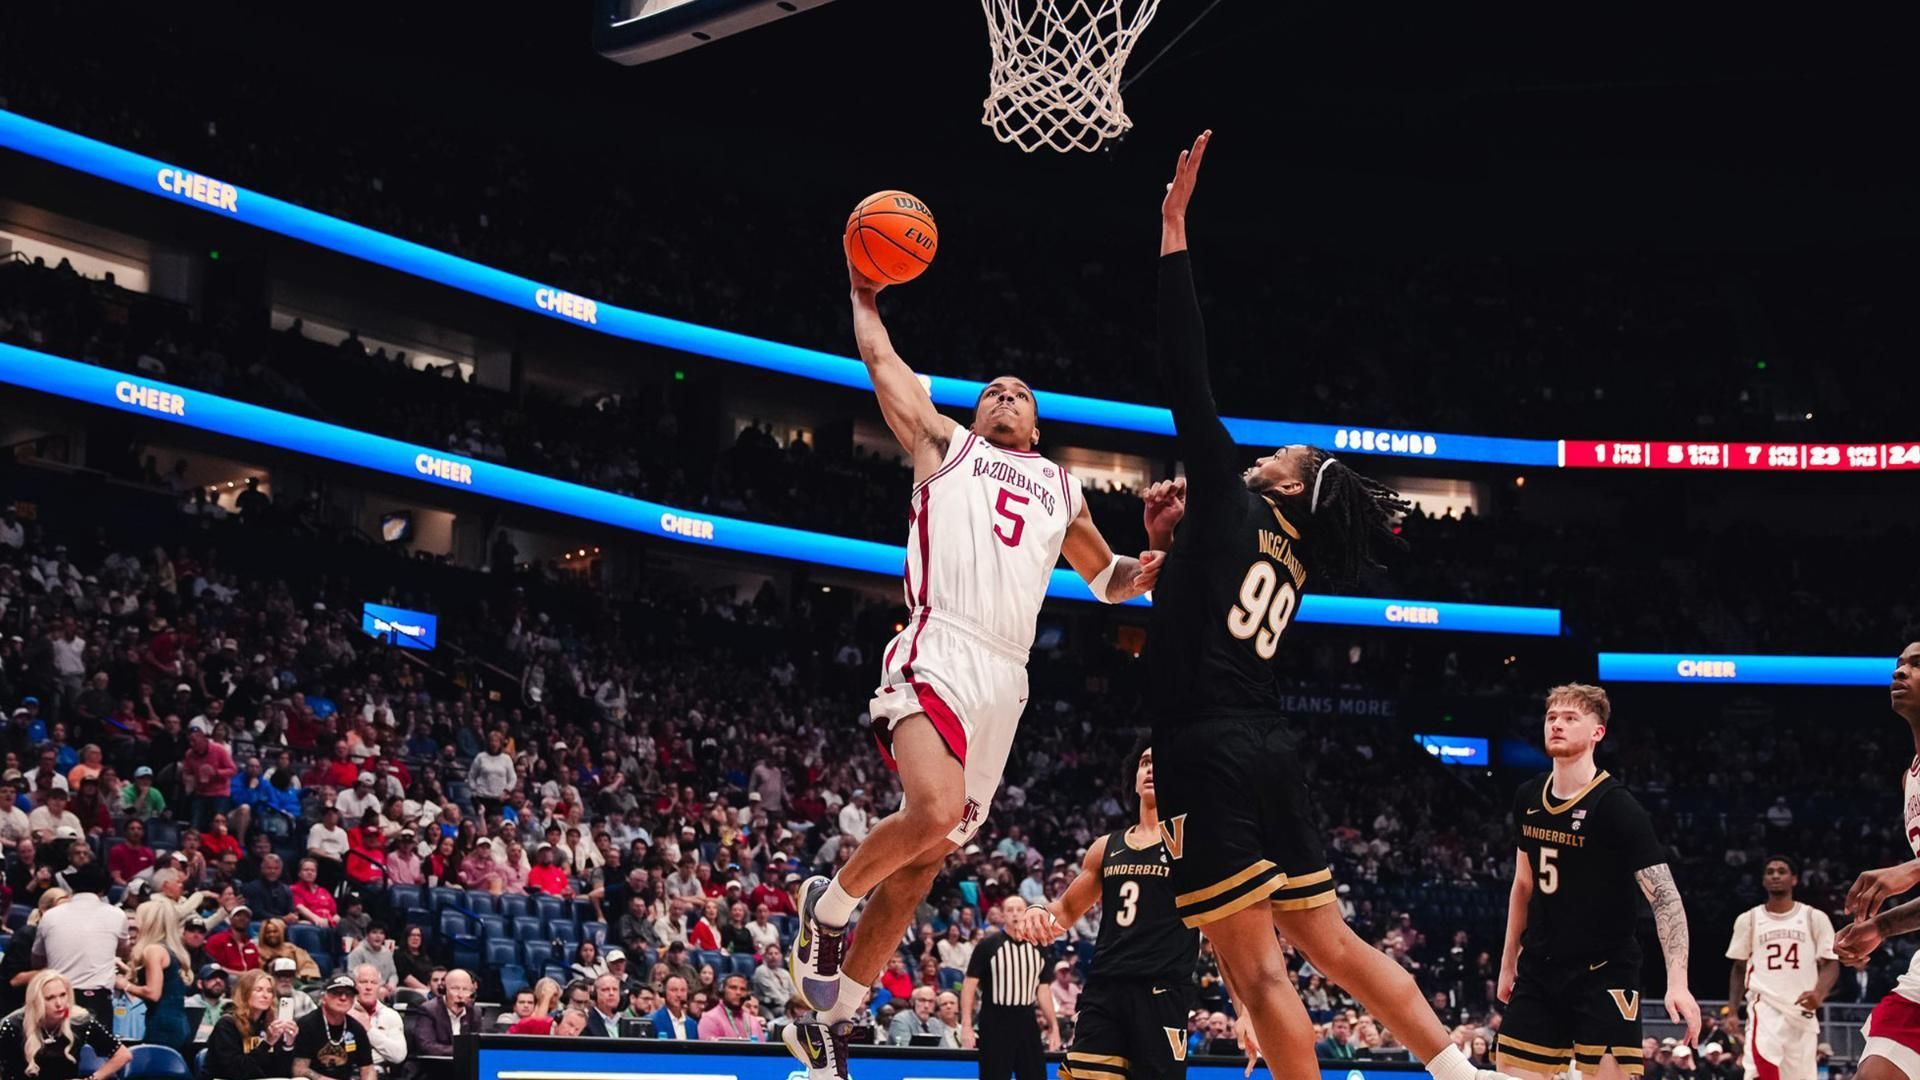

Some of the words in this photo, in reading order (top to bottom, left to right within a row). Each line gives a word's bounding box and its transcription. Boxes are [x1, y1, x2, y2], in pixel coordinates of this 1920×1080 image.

[157, 168, 238, 212] CHEER
[535, 288, 597, 324] CHEER
[115, 381, 185, 416] CHEER
[1334, 429, 1437, 455] #SECMBB
[1594, 443, 1606, 463] 1
[1745, 445, 1762, 465] 7
[415, 453, 472, 484] CHEER
[972, 457, 1055, 517] RAZORBACKS
[660, 513, 714, 540] CHEER
[993, 486, 1030, 548] 5
[1227, 560, 1296, 660] 99
[1385, 605, 1439, 624] CHEER
[1677, 659, 1736, 678] CHEER
[1522, 824, 1585, 848] VANDERBILT
[1103, 864, 1170, 878] VANDERBILT
[1538, 846, 1559, 894] 5
[1116, 880, 1140, 927] 3
[1766, 943, 1800, 970] 24
[1607, 989, 1639, 1021] V
